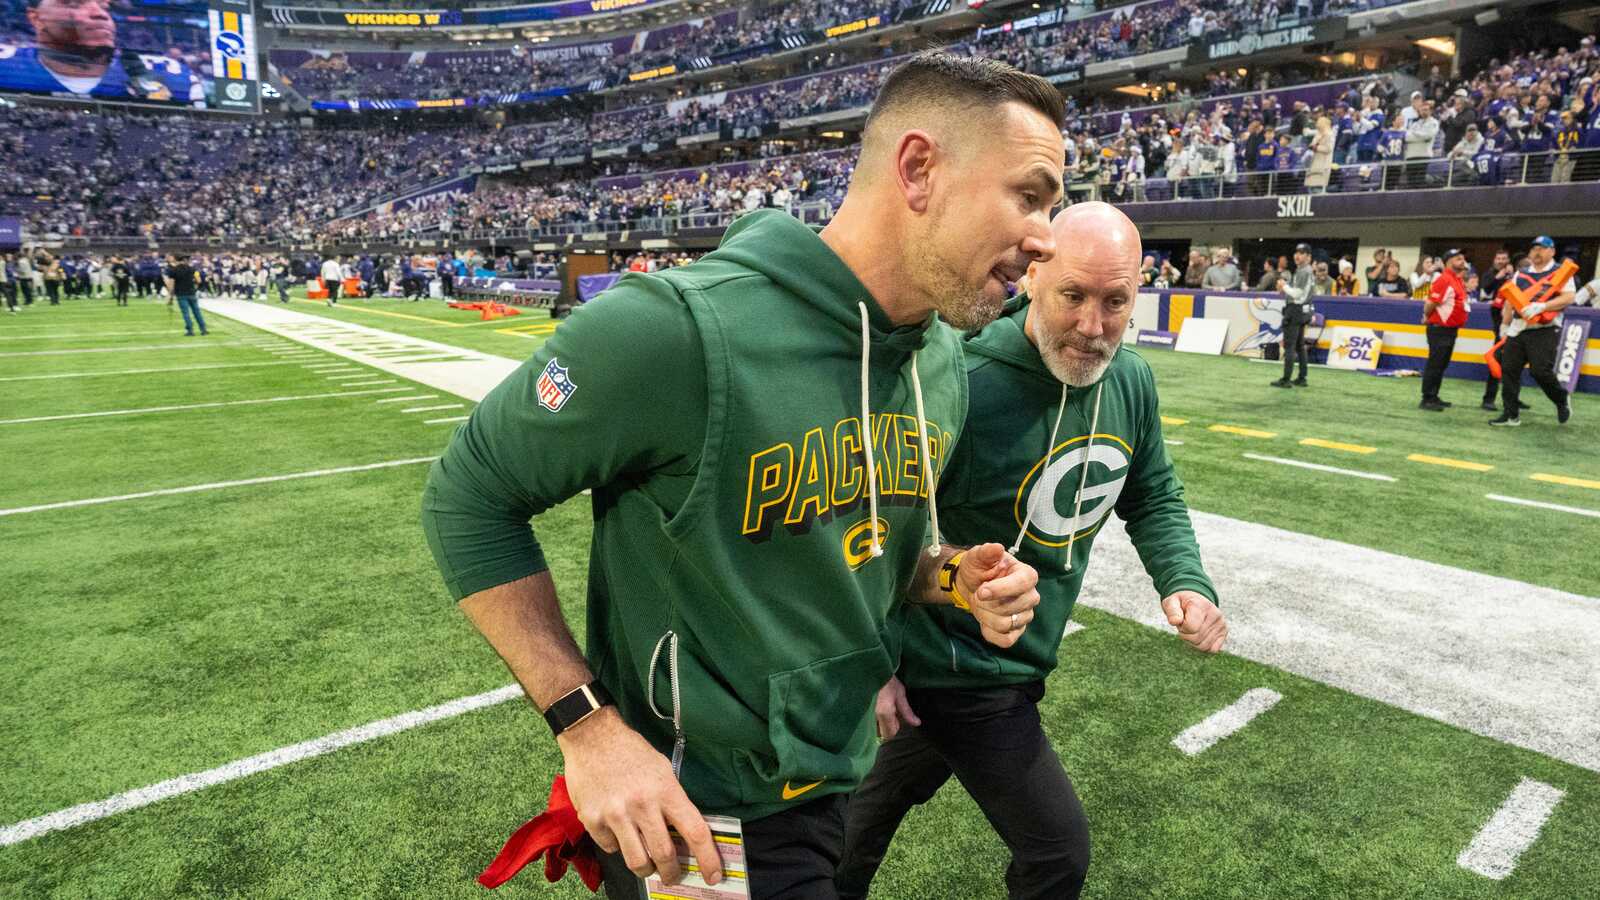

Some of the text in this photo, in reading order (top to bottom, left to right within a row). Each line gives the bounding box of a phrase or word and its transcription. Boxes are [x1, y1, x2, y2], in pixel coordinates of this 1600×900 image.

[345, 13, 420, 25] VIKINGS
[1277, 195, 1314, 217] SKOL
[1347, 349, 1373, 361] OL
[1349, 335, 1375, 349] SK
[538, 373, 562, 408] NFL
[741, 412, 953, 540] PACKER
[1026, 443, 1130, 537] G
[842, 516, 890, 571] G
